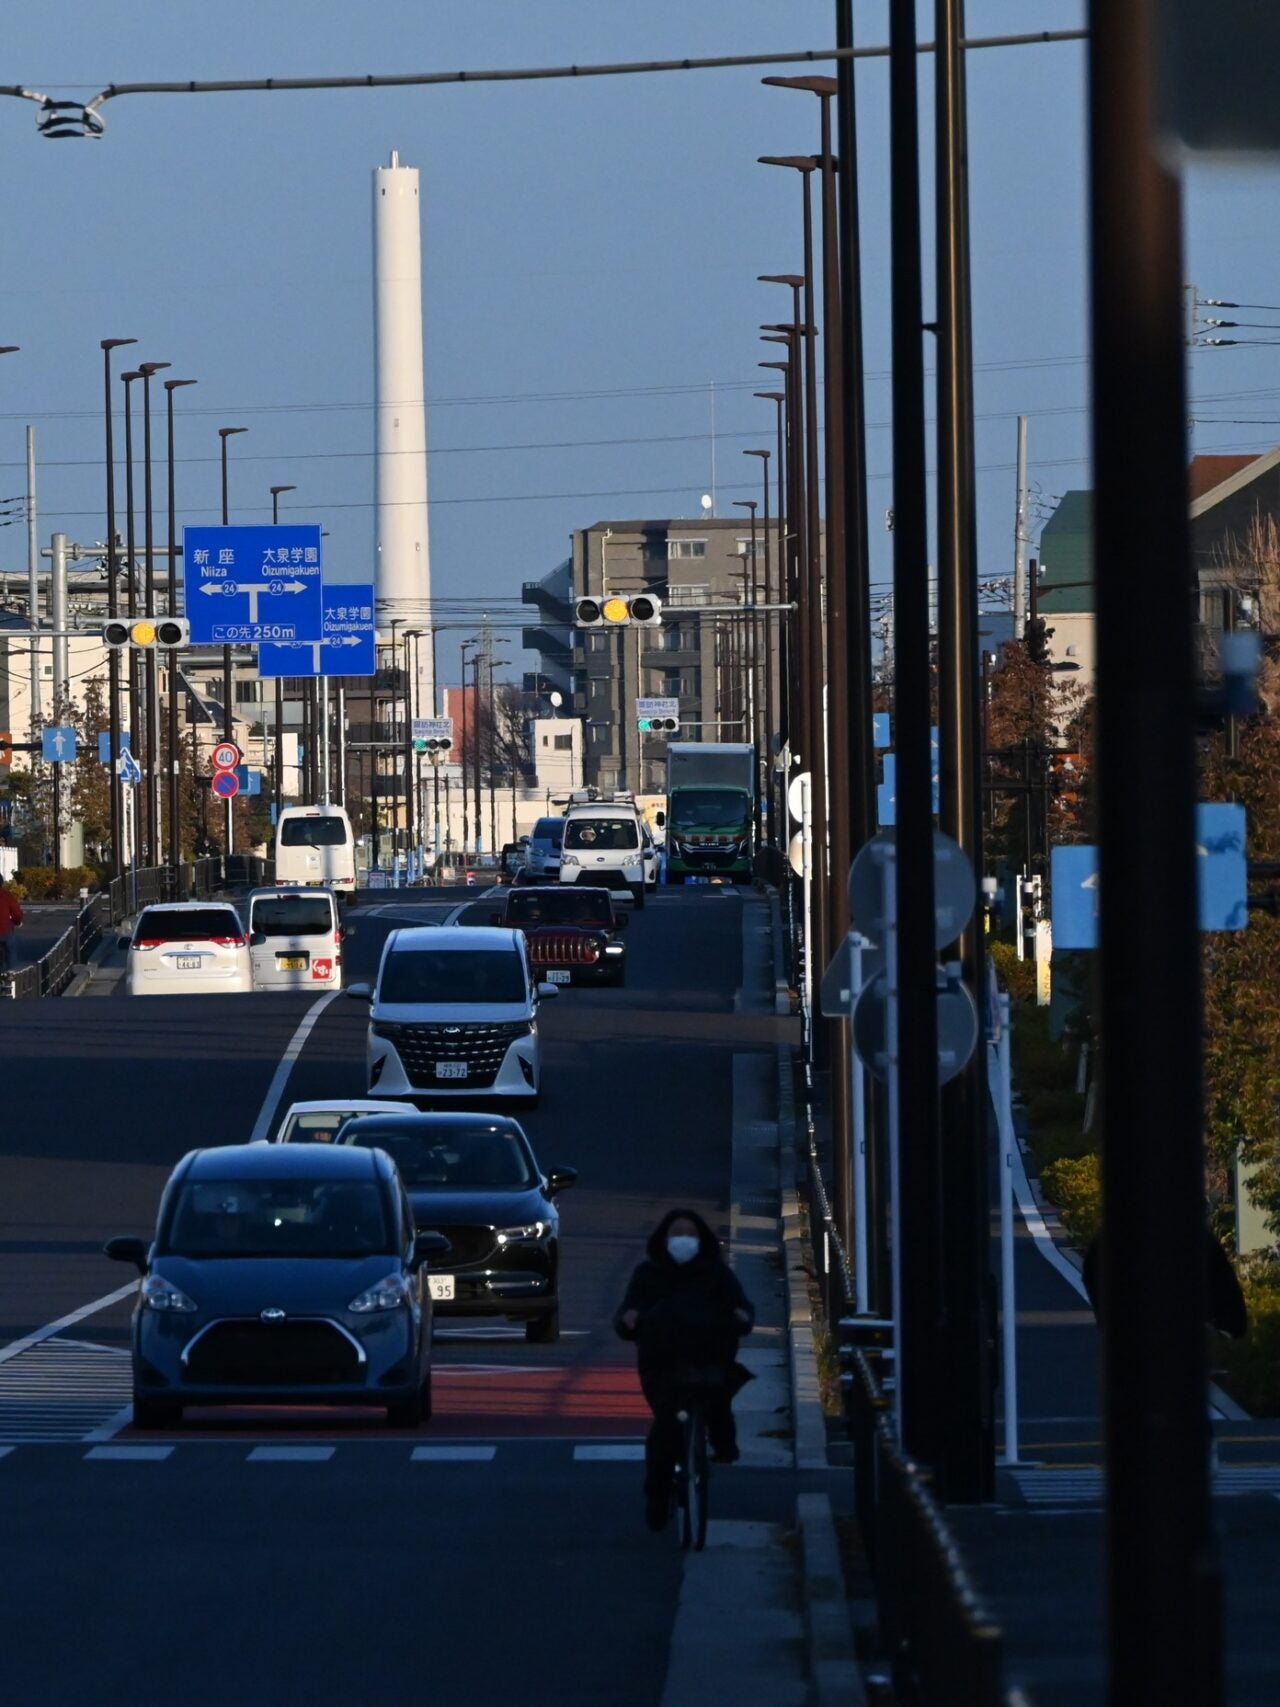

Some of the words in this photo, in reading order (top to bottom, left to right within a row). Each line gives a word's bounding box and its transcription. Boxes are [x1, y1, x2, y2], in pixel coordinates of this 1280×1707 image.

[193, 548, 235, 565] 新座
[262, 547, 318, 564] 大泉学園
[201, 565, 228, 577] Niiza
[261, 564, 320, 578] Oizumigakuen
[224, 583, 234, 593] 24
[271, 582, 282, 592] 24
[324, 606, 372, 620] 大泉学園
[323, 621, 373, 633] Oizumigakuen
[331, 636, 342, 646] 24
[218, 751, 233, 763] 40
